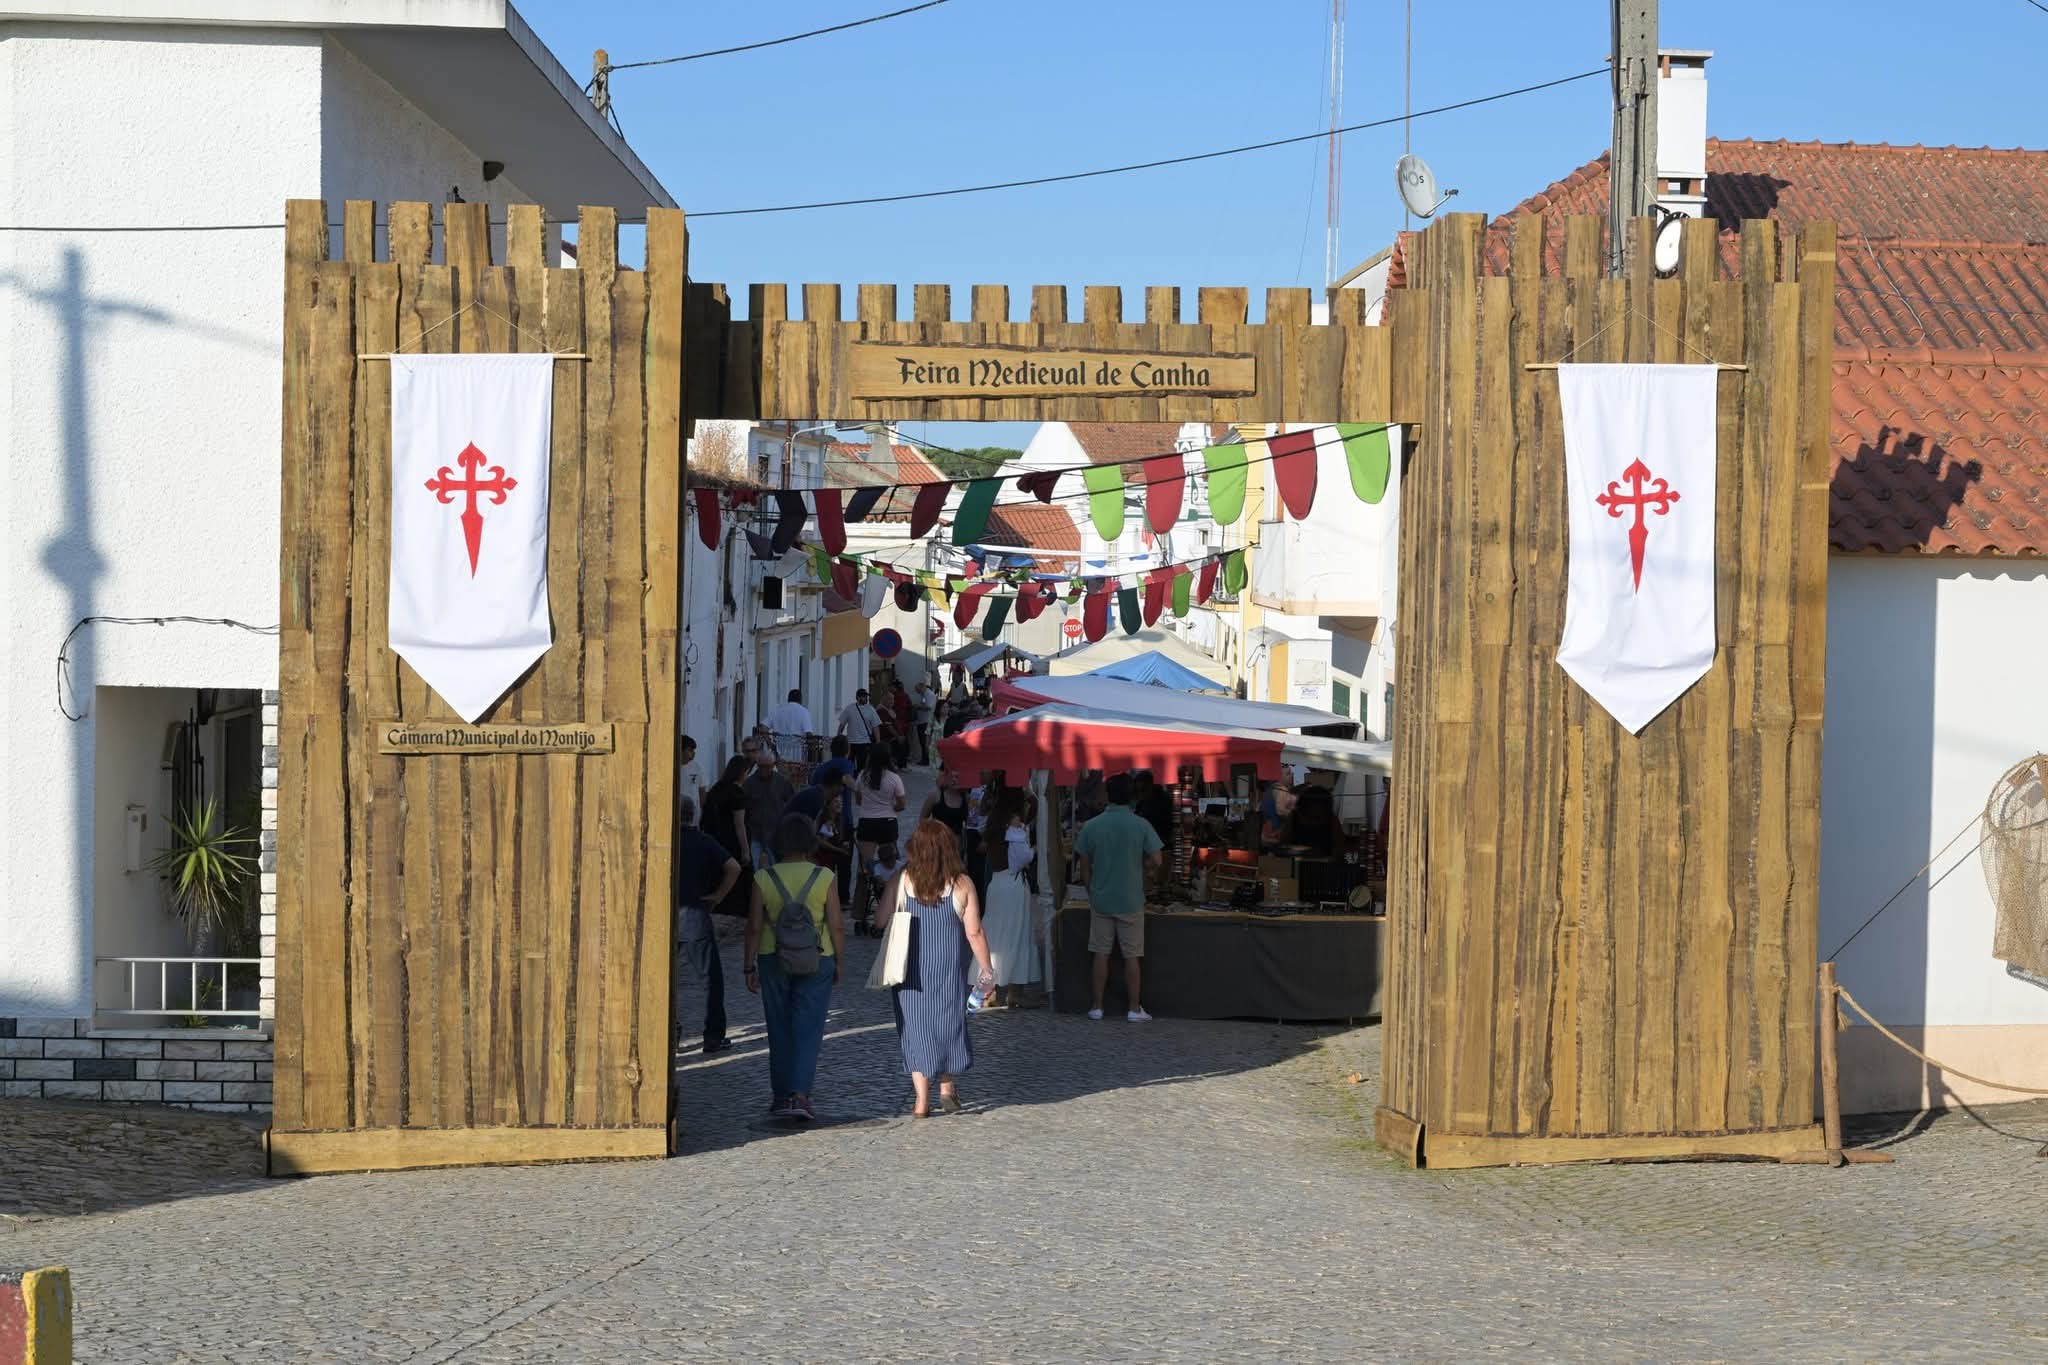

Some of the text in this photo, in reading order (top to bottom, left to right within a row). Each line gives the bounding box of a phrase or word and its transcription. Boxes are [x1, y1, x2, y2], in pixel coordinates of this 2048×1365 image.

[1402, 171, 1425, 187] NOS
[895, 357, 1211, 388] Feira Medieval de Canha
[1064, 624, 1082, 632] STOP
[387, 728, 596, 749] Câmara Municipal do Montijo
